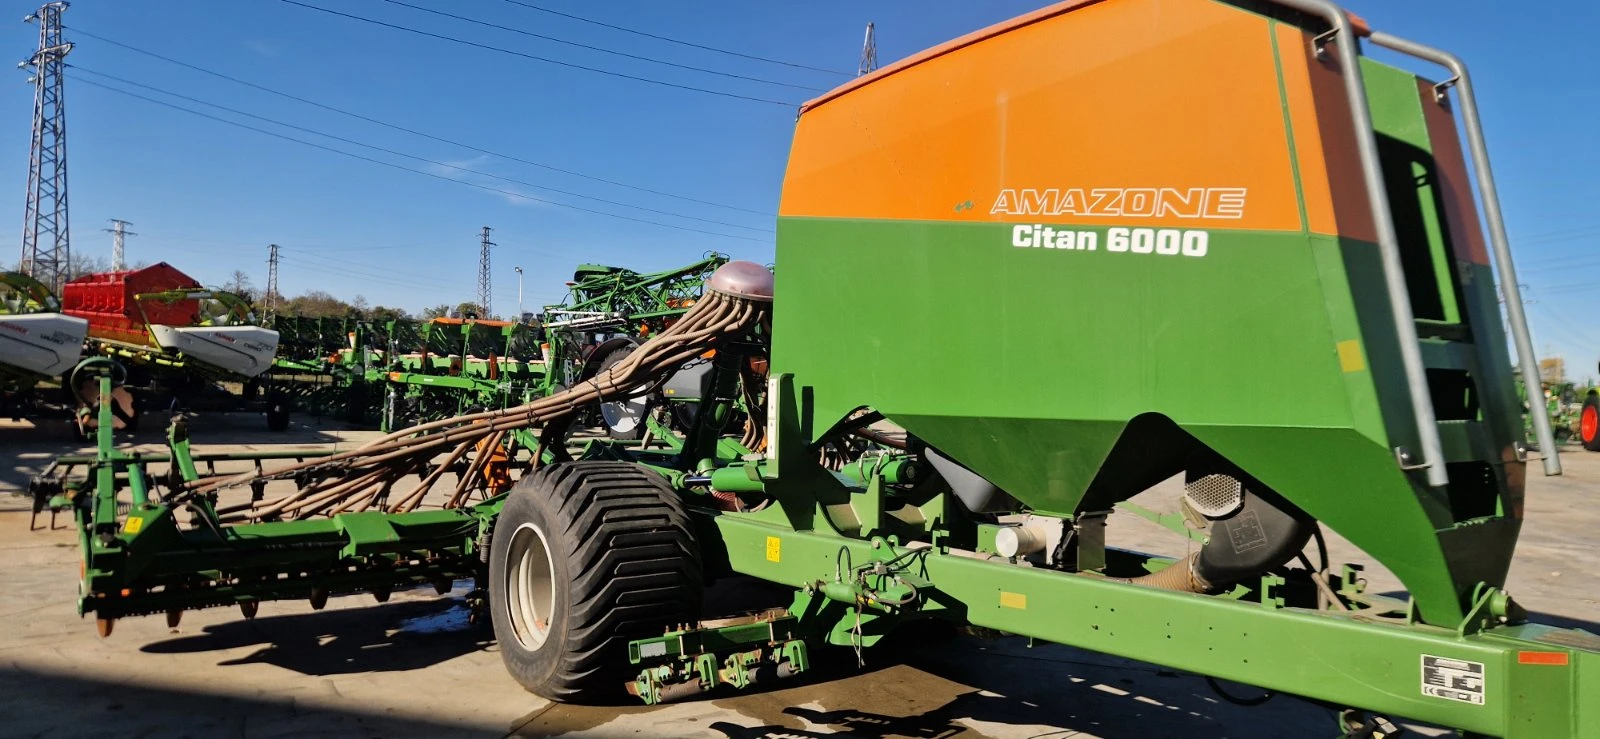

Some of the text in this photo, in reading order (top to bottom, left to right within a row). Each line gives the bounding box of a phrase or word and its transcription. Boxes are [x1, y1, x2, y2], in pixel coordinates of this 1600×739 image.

[989, 187, 1248, 219] AMAZONE
[1012, 224, 1209, 257] Citan 6000
